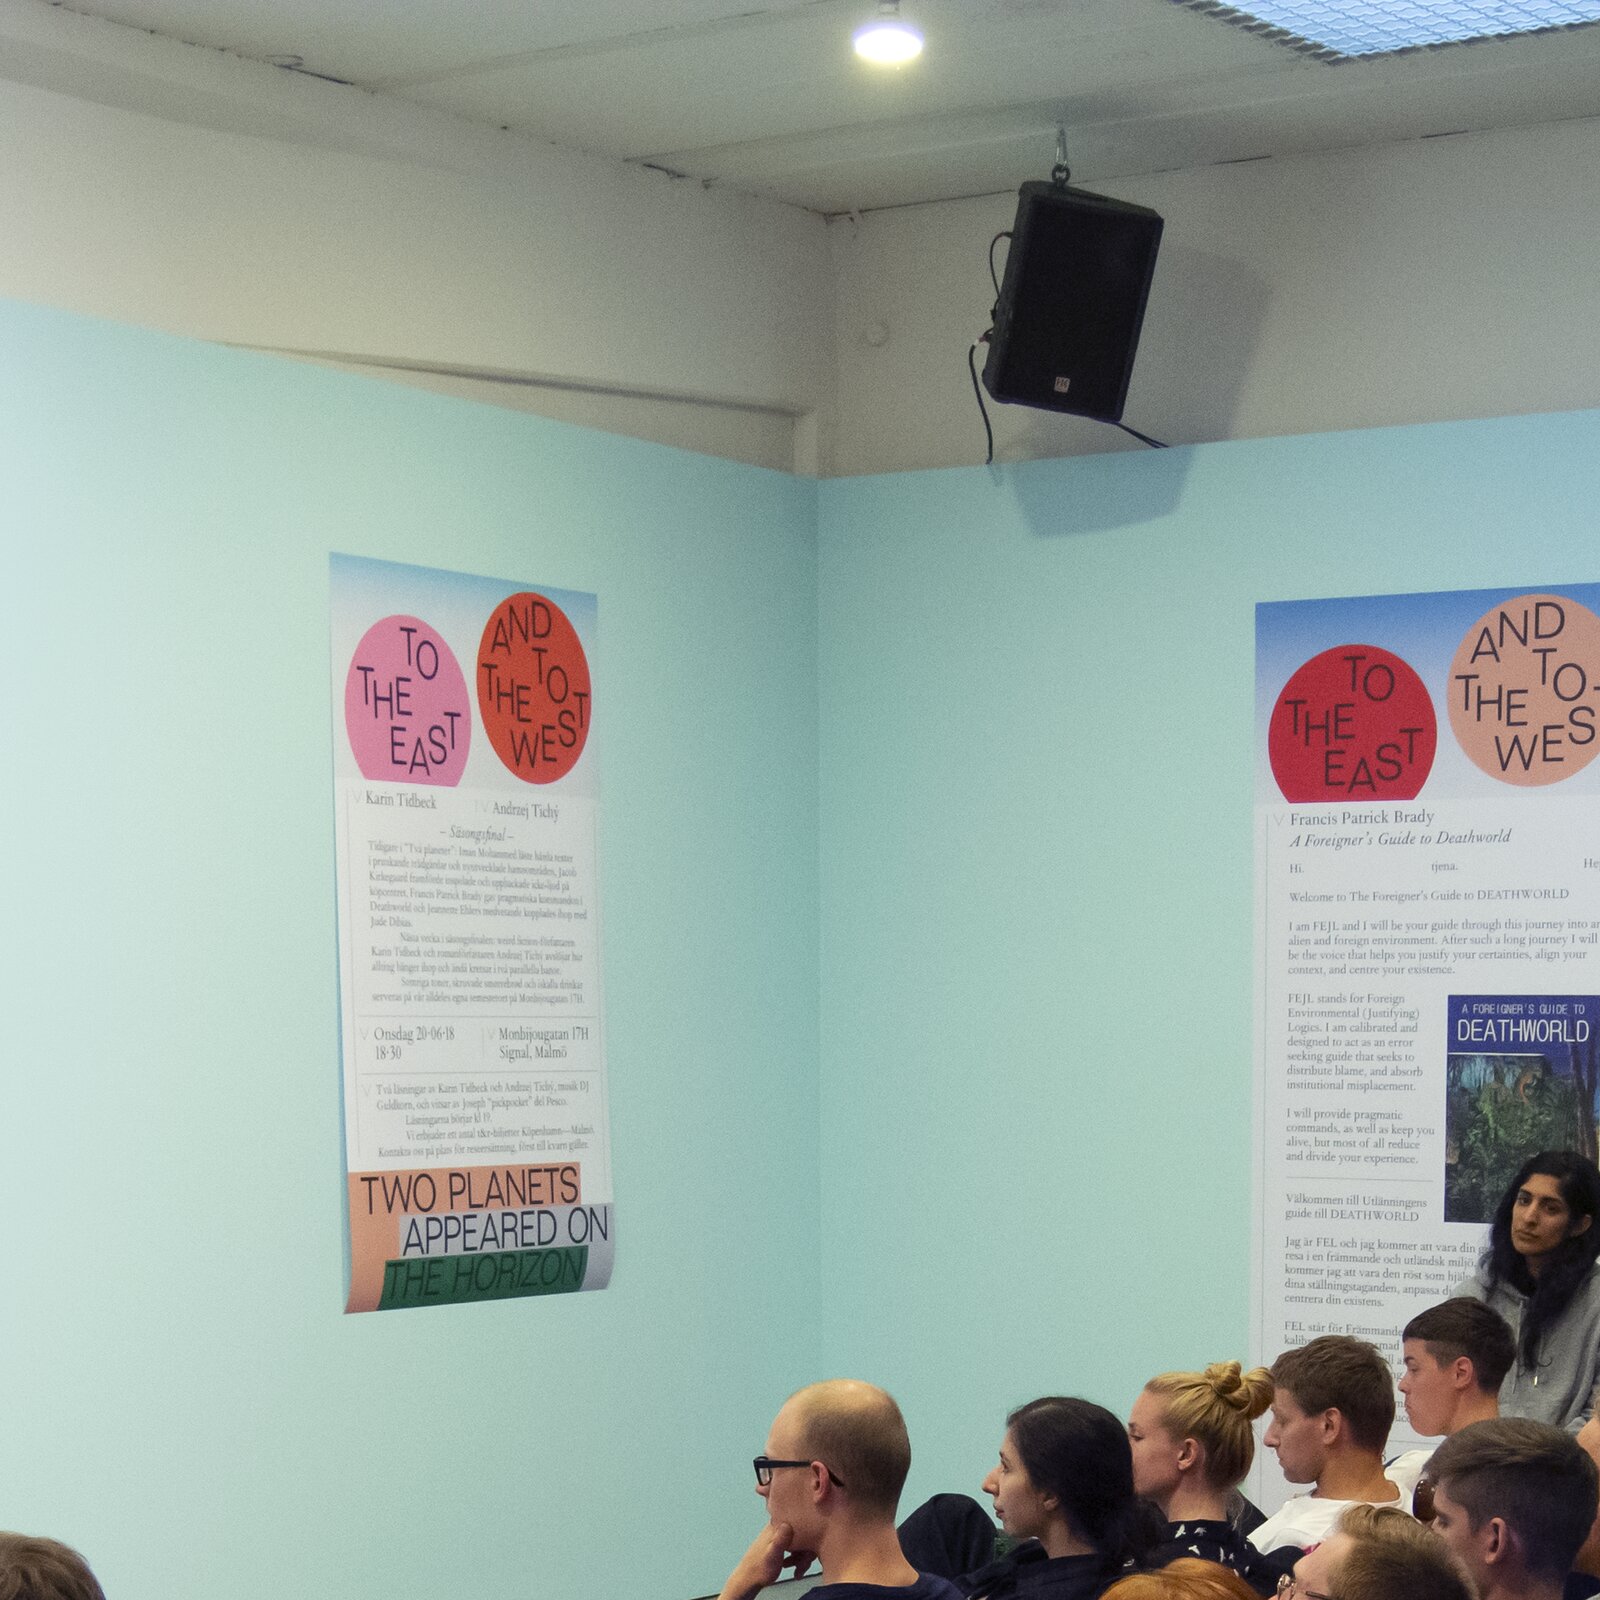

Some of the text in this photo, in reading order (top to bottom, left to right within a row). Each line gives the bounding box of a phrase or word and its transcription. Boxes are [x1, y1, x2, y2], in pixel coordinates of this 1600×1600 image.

[491, 601, 550, 655] AND
[1471, 602, 1565, 663] AND
[400, 627, 439, 680] TO
[532, 647, 568, 704] TO
[1344, 656, 1395, 701] TO
[1533, 648, 1586, 702] TO
[357, 666, 412, 720] THE
[482, 663, 532, 723] THE
[1455, 675, 1528, 726] THE
[511, 692, 588, 769] WEST
[1285, 700, 1355, 746] THE
[391, 712, 461, 776] EAST
[1325, 728, 1424, 793] EAST
[366, 790, 436, 809] Karin Tidbeck
[493, 801, 559, 823] Andrzej Tichý
[1291, 809, 1434, 826] Francis Patrick Brady
[450, 825, 506, 843] Säsongsfinal
[1290, 829, 1511, 850] A Foreigner's Guide to Deathworld
[1290, 864, 1304, 873] Hi.
[1290, 891, 1334, 901] Welcome
[1337, 891, 1346, 901] to
[1349, 891, 1370, 900] The
[1431, 890, 1461, 900] Guide
[1464, 890, 1474, 899] to
[1477, 889, 1569, 899] DEATHWORLD
[1296, 922, 1310, 930] am
[1313, 921, 1339, 931] FEJL
[1342, 920, 1360, 930] and
[1371, 920, 1388, 930] will
[1391, 920, 1403, 930] be
[1406, 922, 1428, 932] your
[1431, 920, 1458, 932] guide
[1462, 920, 1501, 932] through
[1505, 919, 1522, 929] this
[1525, 919, 1564, 932] journey
[1568, 919, 1588, 929] into
[1289, 935, 1311, 945] alien
[1314, 935, 1331, 945] and
[1335, 935, 1369, 947] foreign
[1372, 934, 1437, 945] environment.
[1442, 934, 1468, 944] After
[1470, 934, 1492, 944] such
[1504, 934, 1526, 947] long
[1529, 934, 1568, 946] journey
[1579, 934, 1597, 943] will
[1288, 949, 1587, 962] be the voice that helps you justify your certainties, align your
[1288, 964, 1455, 976] context, and centre your existence.
[1289, 993, 1404, 1006] FEJL stands for Foreign
[1288, 1008, 1419, 1021] Environmental (Justifying)
[1462, 1004, 1585, 1015] A FOREIGNER'S GUIDE TO
[374, 1027, 414, 1042] Onsdag
[499, 1027, 588, 1042] Monbijougatan 17H
[1288, 1022, 1322, 1034] Logics.
[1332, 1024, 1347, 1032] am
[1349, 1022, 1397, 1032] calibrated
[1400, 1023, 1418, 1032] and
[1457, 1019, 1589, 1042] DEATHWORLD
[500, 1044, 567, 1062] Signal, Malmö
[1287, 1051, 1414, 1063] seeking guide that seeks to
[1287, 1065, 1423, 1078] distribute blame, and absorb
[1287, 1079, 1415, 1093] institutional misplacement.
[1294, 1108, 1311, 1118] will
[1314, 1108, 1351, 1121] provide
[1354, 1109, 1402, 1122] pragmatic
[1286, 1151, 1418, 1165] and divide your experience.
[361, 1166, 579, 1215] TWO PLANETS
[1287, 1193, 1427, 1209] Välkommen till Utlänningens
[1285, 1208, 1419, 1221] guide till DEATHWORLD
[403, 1206, 608, 1256] APPEARED ON
[1285, 1252, 1304, 1261] resa
[1312, 1253, 1324, 1262] en
[1327, 1252, 1381, 1264] främmande
[1383, 1253, 1401, 1264] och
[1404, 1254, 1445, 1266] utländsk
[1448, 1255, 1476, 1269] miljö.
[386, 1249, 583, 1300] THE HORIZON
[1285, 1293, 1384, 1306] centrera din existens.
